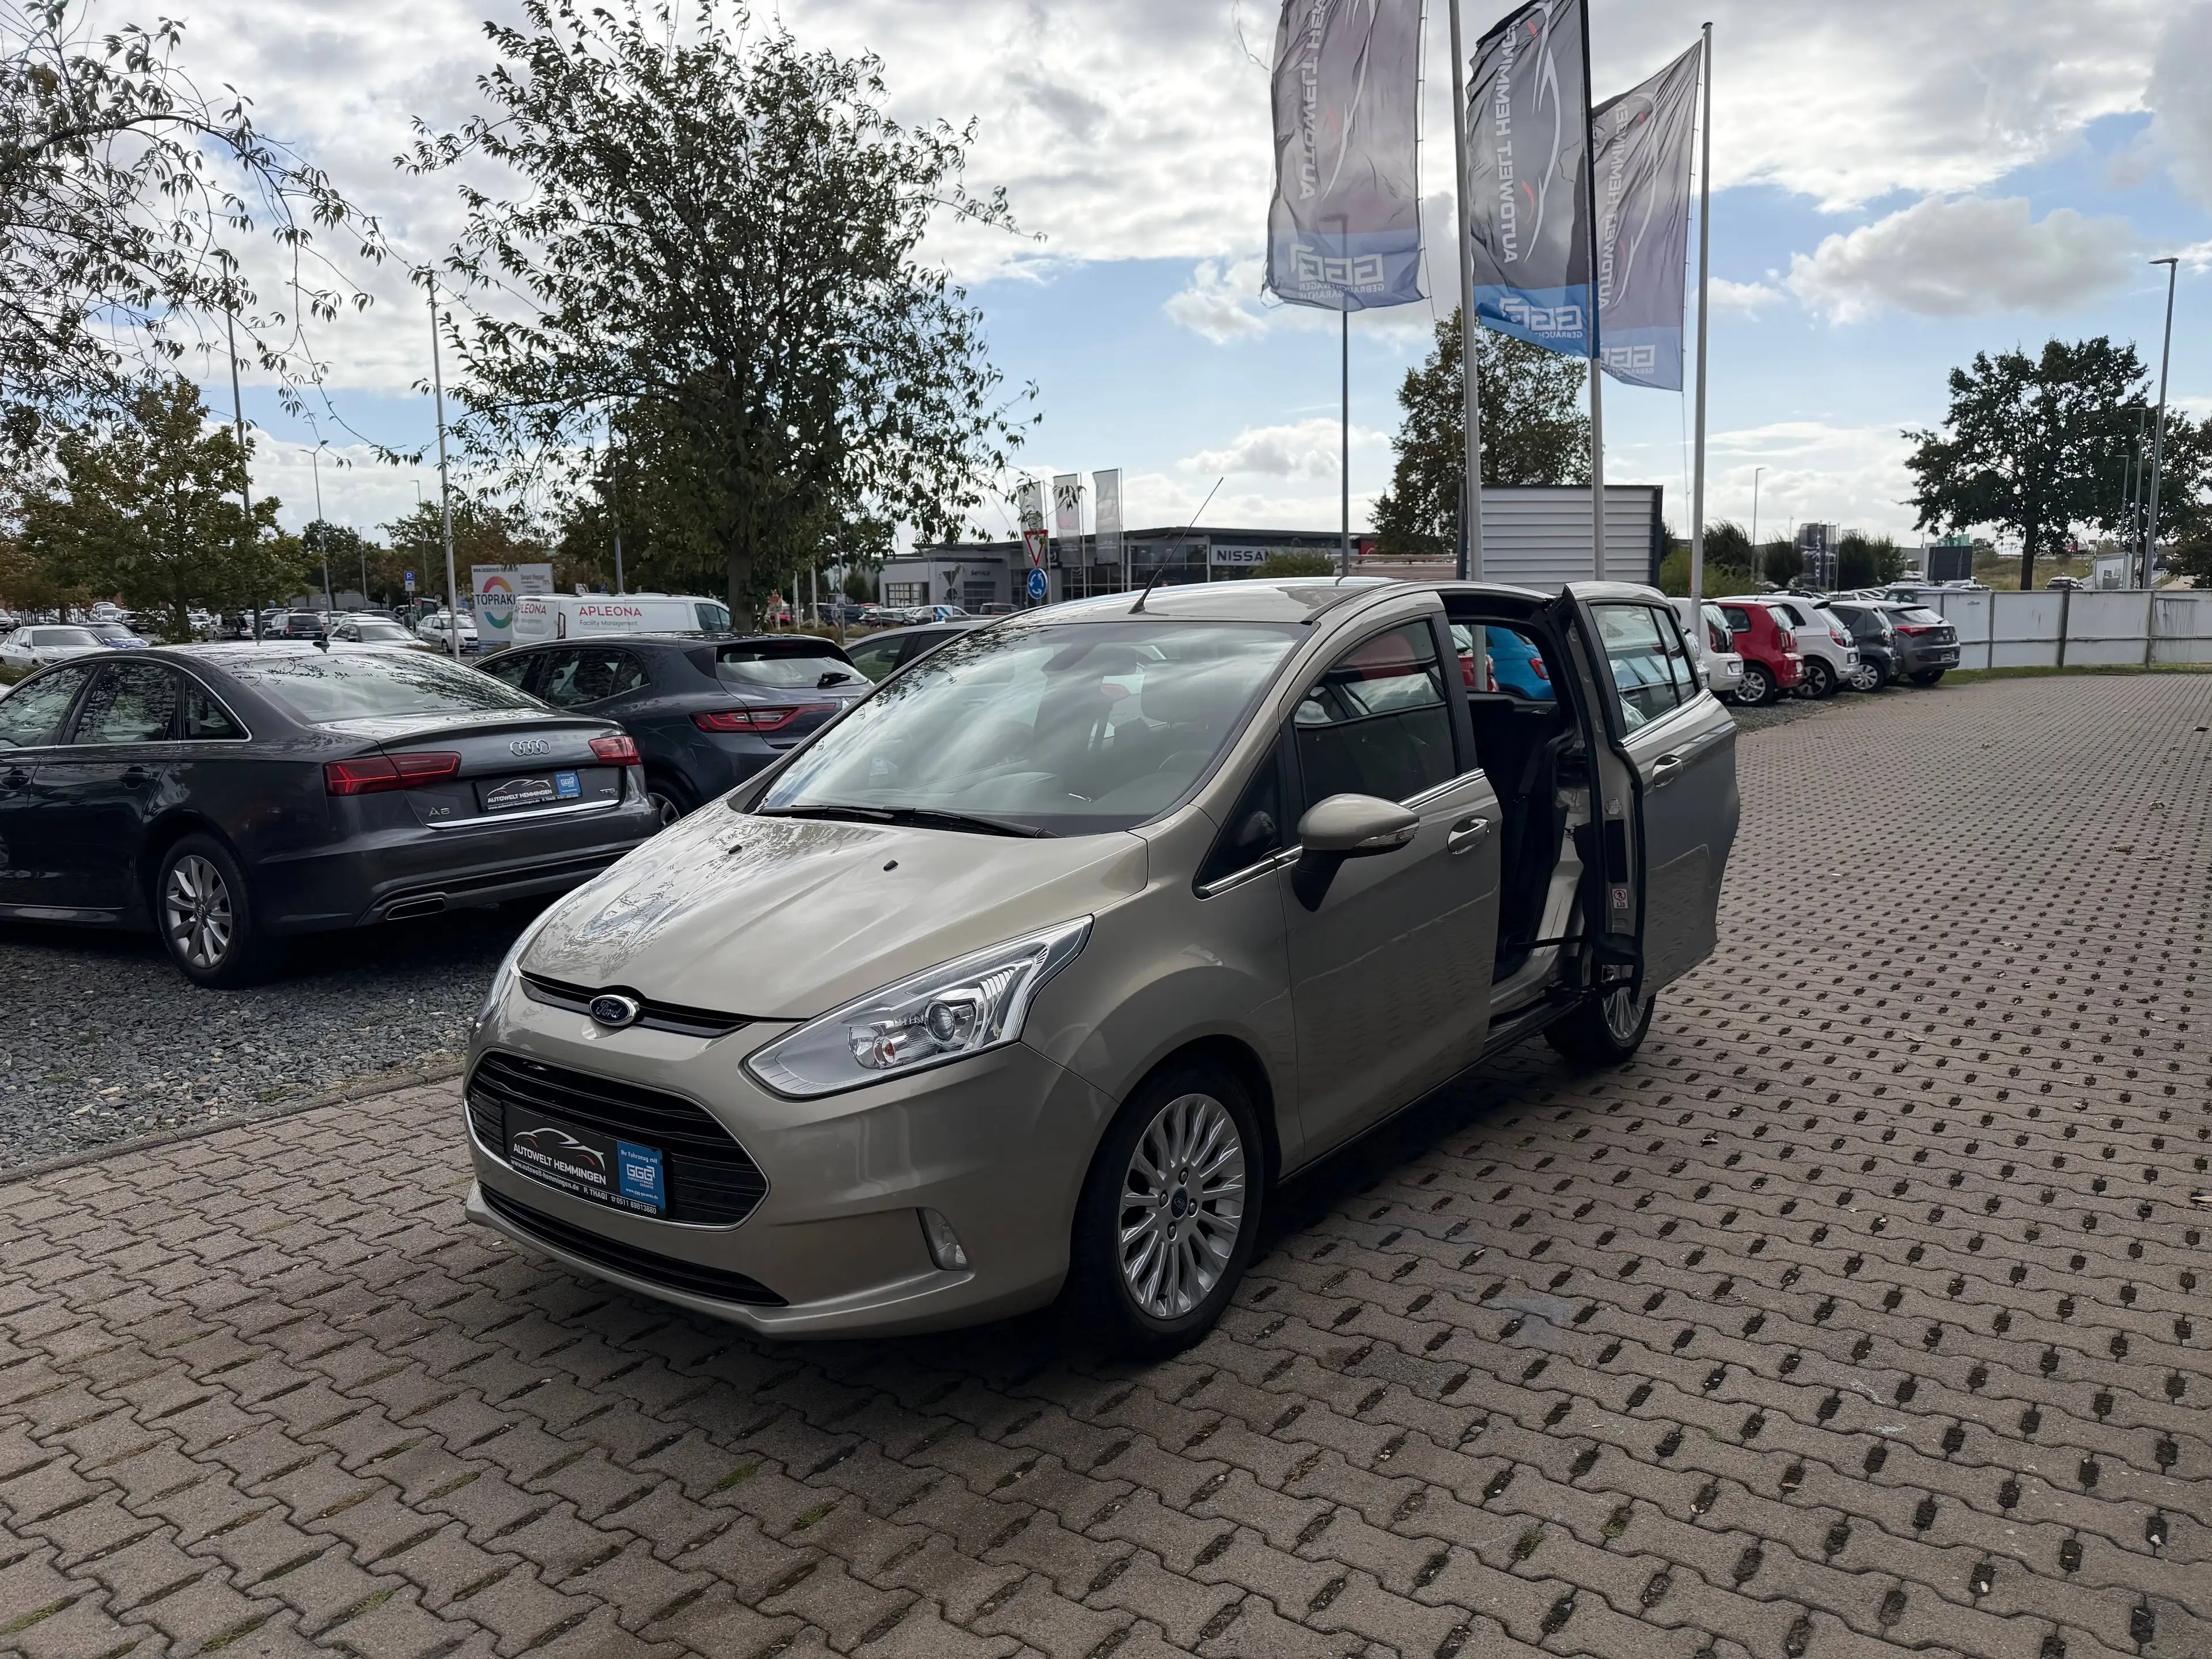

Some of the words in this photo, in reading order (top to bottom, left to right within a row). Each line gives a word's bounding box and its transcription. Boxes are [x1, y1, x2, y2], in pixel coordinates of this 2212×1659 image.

[1217, 550, 1269, 562] NISSA
[579, 606, 642, 616] APLEONA
[487, 794, 518, 804] AUTOWELT
[519, 789, 552, 798] HEMMINGEN
[596, 1000, 622, 1018] Ford
[513, 1143, 552, 1166] AUTOWELT
[554, 1159, 607, 1185] HEMMINGEN
[628, 1152, 649, 1163] Fahrzeug
[626, 1164, 655, 1182] GGG
[510, 1158, 579, 1191] www.autowelt-hemmingen.de
[590, 1190, 608, 1200] THAQI
[616, 1198, 629, 1207] 0511
